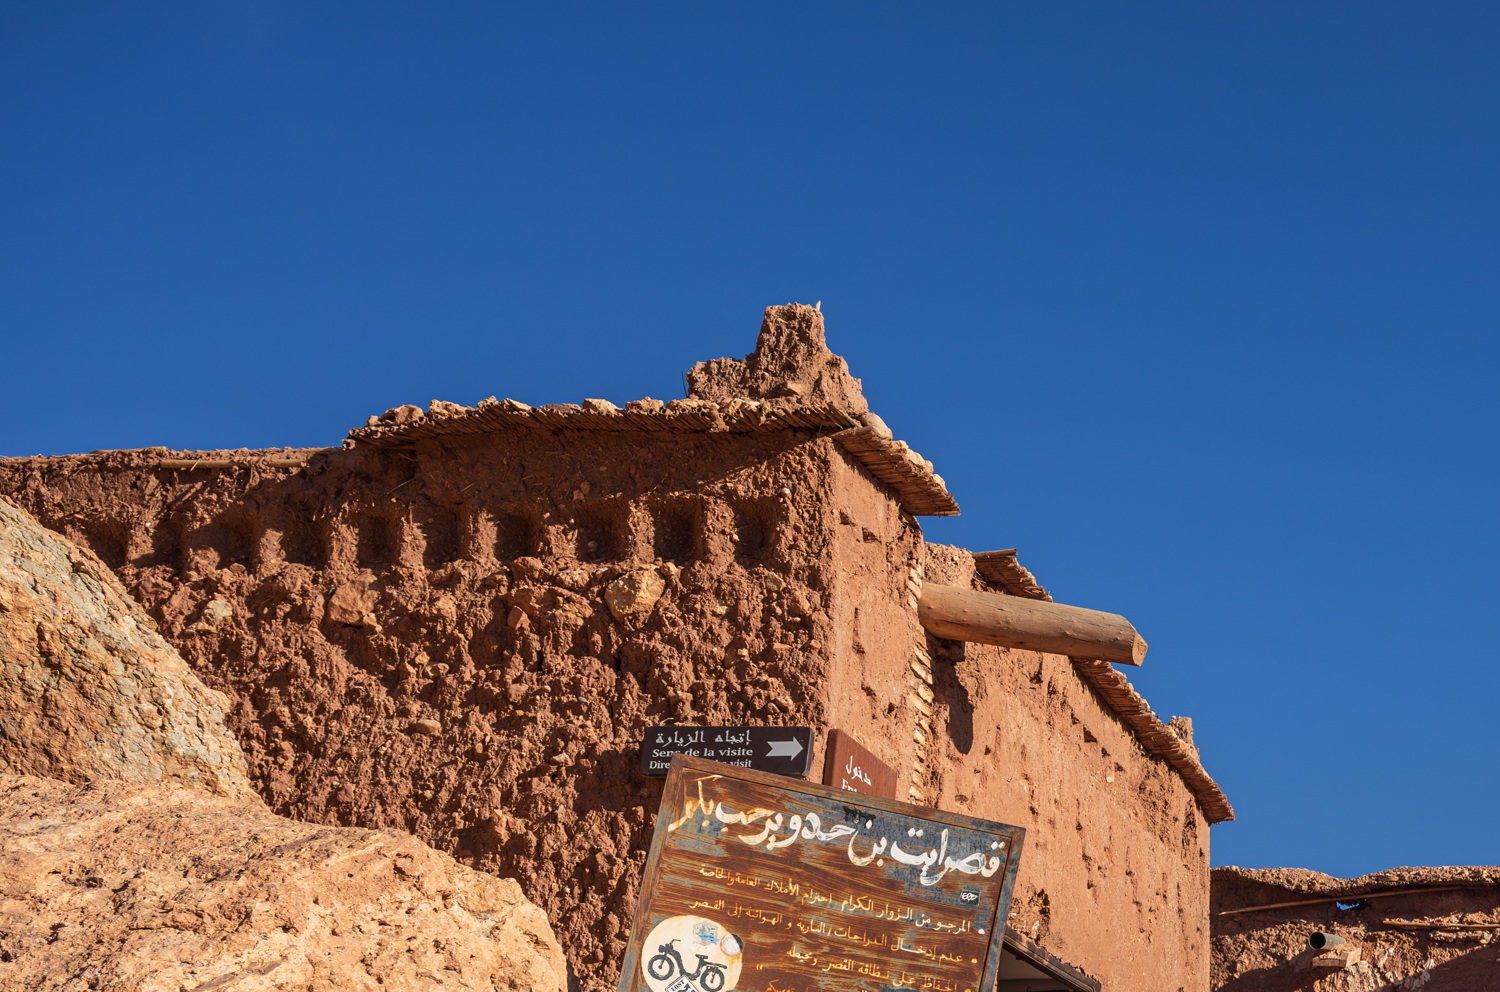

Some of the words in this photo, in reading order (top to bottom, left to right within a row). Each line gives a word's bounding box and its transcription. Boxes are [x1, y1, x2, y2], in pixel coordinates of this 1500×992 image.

[655, 730, 706, 748] الزيارة
[684, 748, 700, 757] de
[703, 748, 715, 757] la
[718, 747, 753, 757] visite
[768, 812, 857, 849] حدو
[847, 819, 888, 867] بن
[841, 894, 874, 912] الكرام
[822, 958, 854, 972] القصر
[671, 979, 686, 992] LOST
